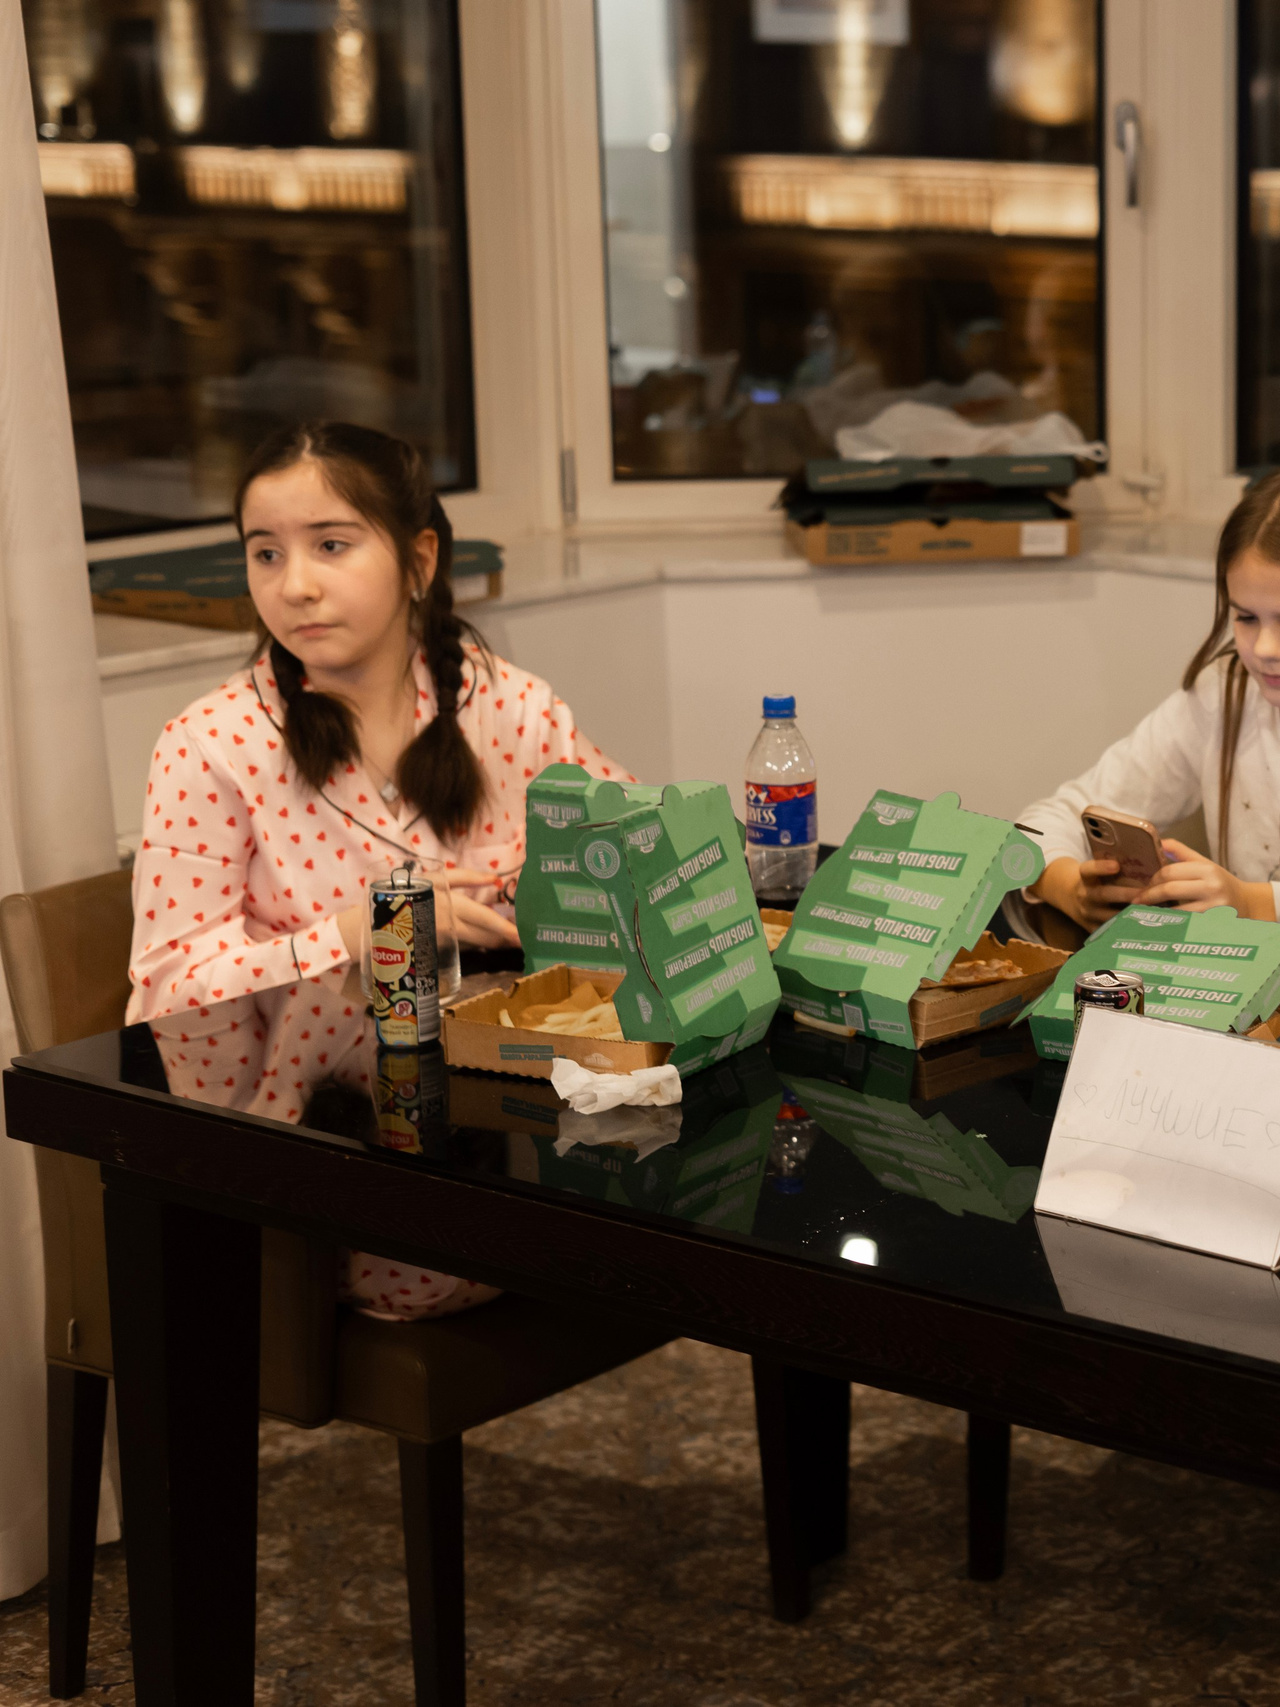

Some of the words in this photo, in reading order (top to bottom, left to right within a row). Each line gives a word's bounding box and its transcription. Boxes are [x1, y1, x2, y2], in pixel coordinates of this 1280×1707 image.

[540, 859, 580, 874] РЧИК?
[678, 840, 723, 882] ЛЮБИШЬ
[849, 849, 894, 865] ПЕРЧИК?
[897, 851, 963, 871] ЛЮБИШЬ
[648, 875, 680, 905] ПЕРЧИК?
[852, 880, 881, 896] СЫР?
[882, 882, 946, 912] ЛЮБИШЬ
[563, 893, 596, 910] СЫР?
[692, 886, 739, 920] ЛЮБИШЬ
[810, 904, 872, 929] ПЕППЕРОНИ?
[536, 928, 608, 948] ПЕППЕРОНИ?
[710, 919, 756, 956] ЛЮБИШЬ
[873, 916, 938, 944] ЛЮБИШЬ
[846, 944, 910, 969] ЛЮБИШЬ
[1112, 941, 1170, 953] ПЕРЧИК?
[1172, 943, 1253, 958] ЛЮБИШЬ
[664, 945, 711, 979] ПЕППЕРОНИ?
[712, 955, 758, 992] ЛЮБИШЬ
[1162, 962, 1241, 983] ЛЮБИШЬ
[1157, 985, 1238, 1004] ЛЮБИШЬ
[1144, 1003, 1211, 1020] ЛЮБИШ
[1103, 1079, 1265, 1149] ЛУЧШИЕ
